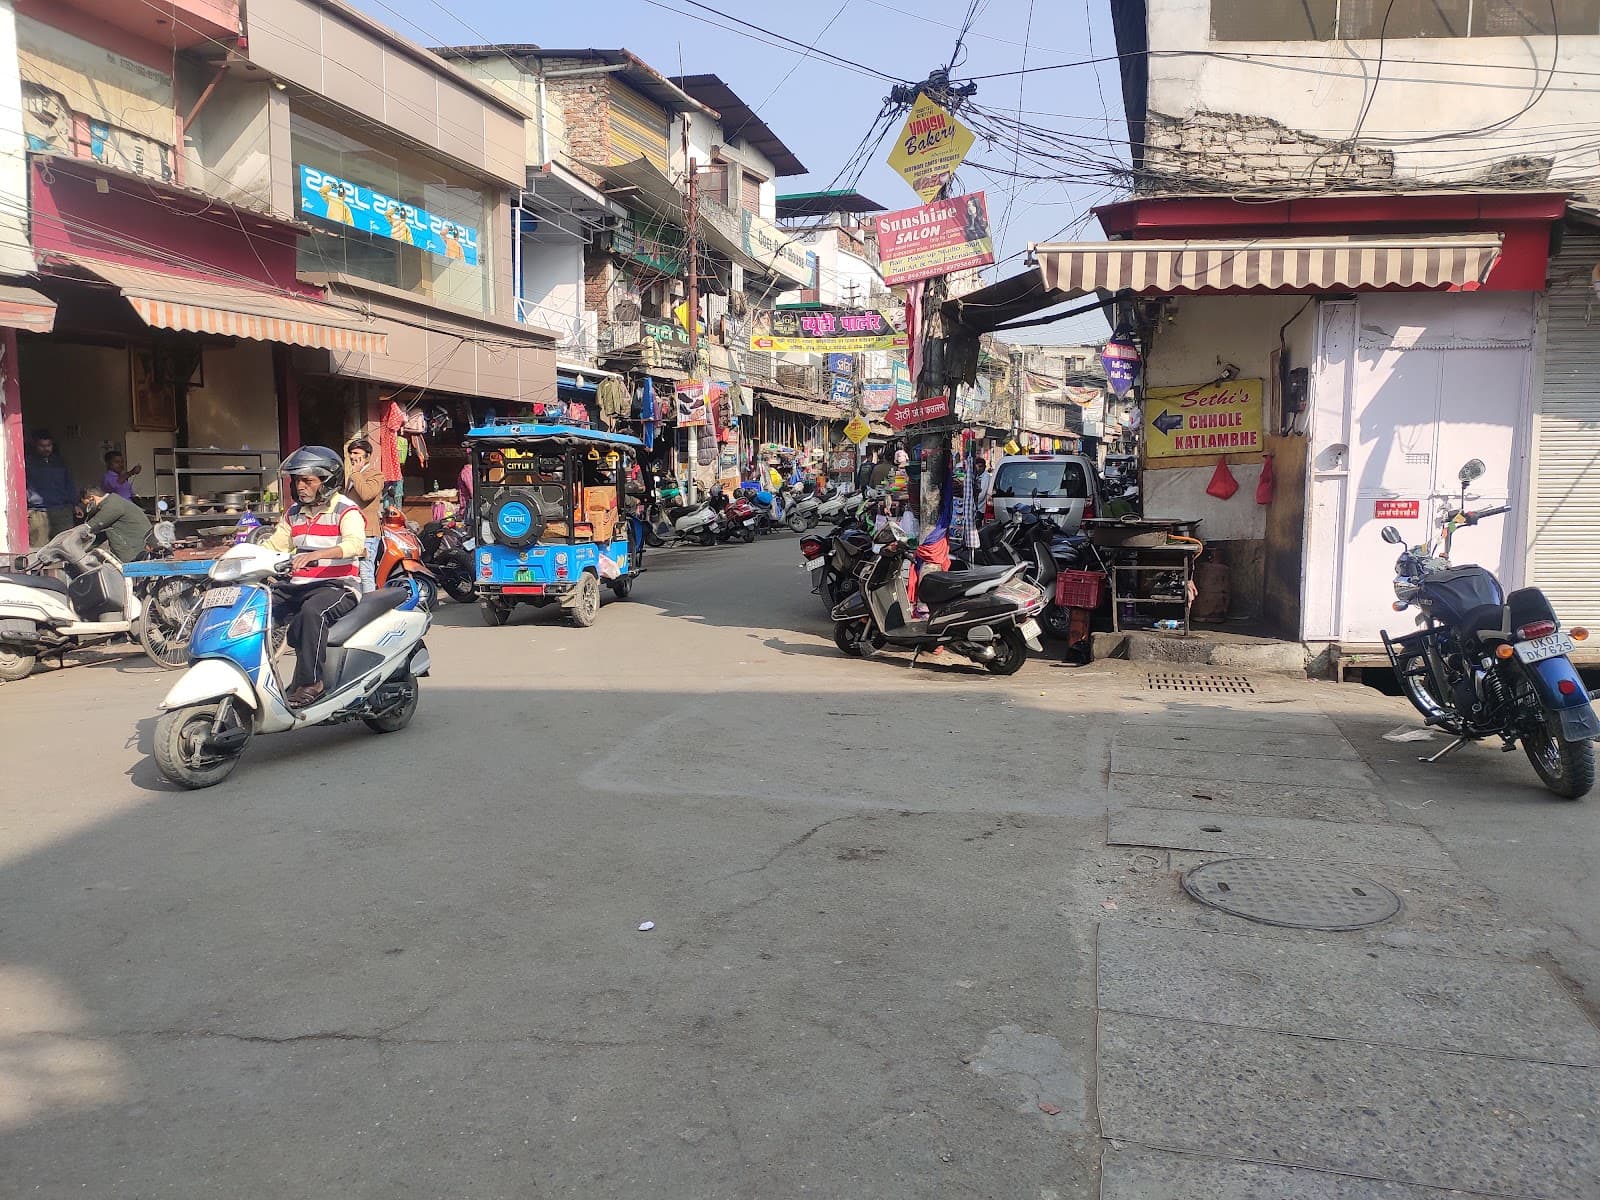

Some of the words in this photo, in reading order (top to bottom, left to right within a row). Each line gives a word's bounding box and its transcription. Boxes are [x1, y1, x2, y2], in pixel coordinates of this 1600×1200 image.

[908, 113, 946, 136] VANSH
[904, 124, 956, 156] Bakery
[880, 206, 957, 234] Sunshine
[895, 224, 941, 245] SALON
[801, 311, 836, 336] ब्यूटी
[840, 310, 882, 332] पार्लर
[1179, 387, 1251, 408] Sethi's
[1188, 411, 1243, 430] CHHOLE
[1174, 430, 1258, 450] KATLAMBHE
[1526, 641, 1572, 661] DK7625
[1530, 634, 1560, 649] UK07
